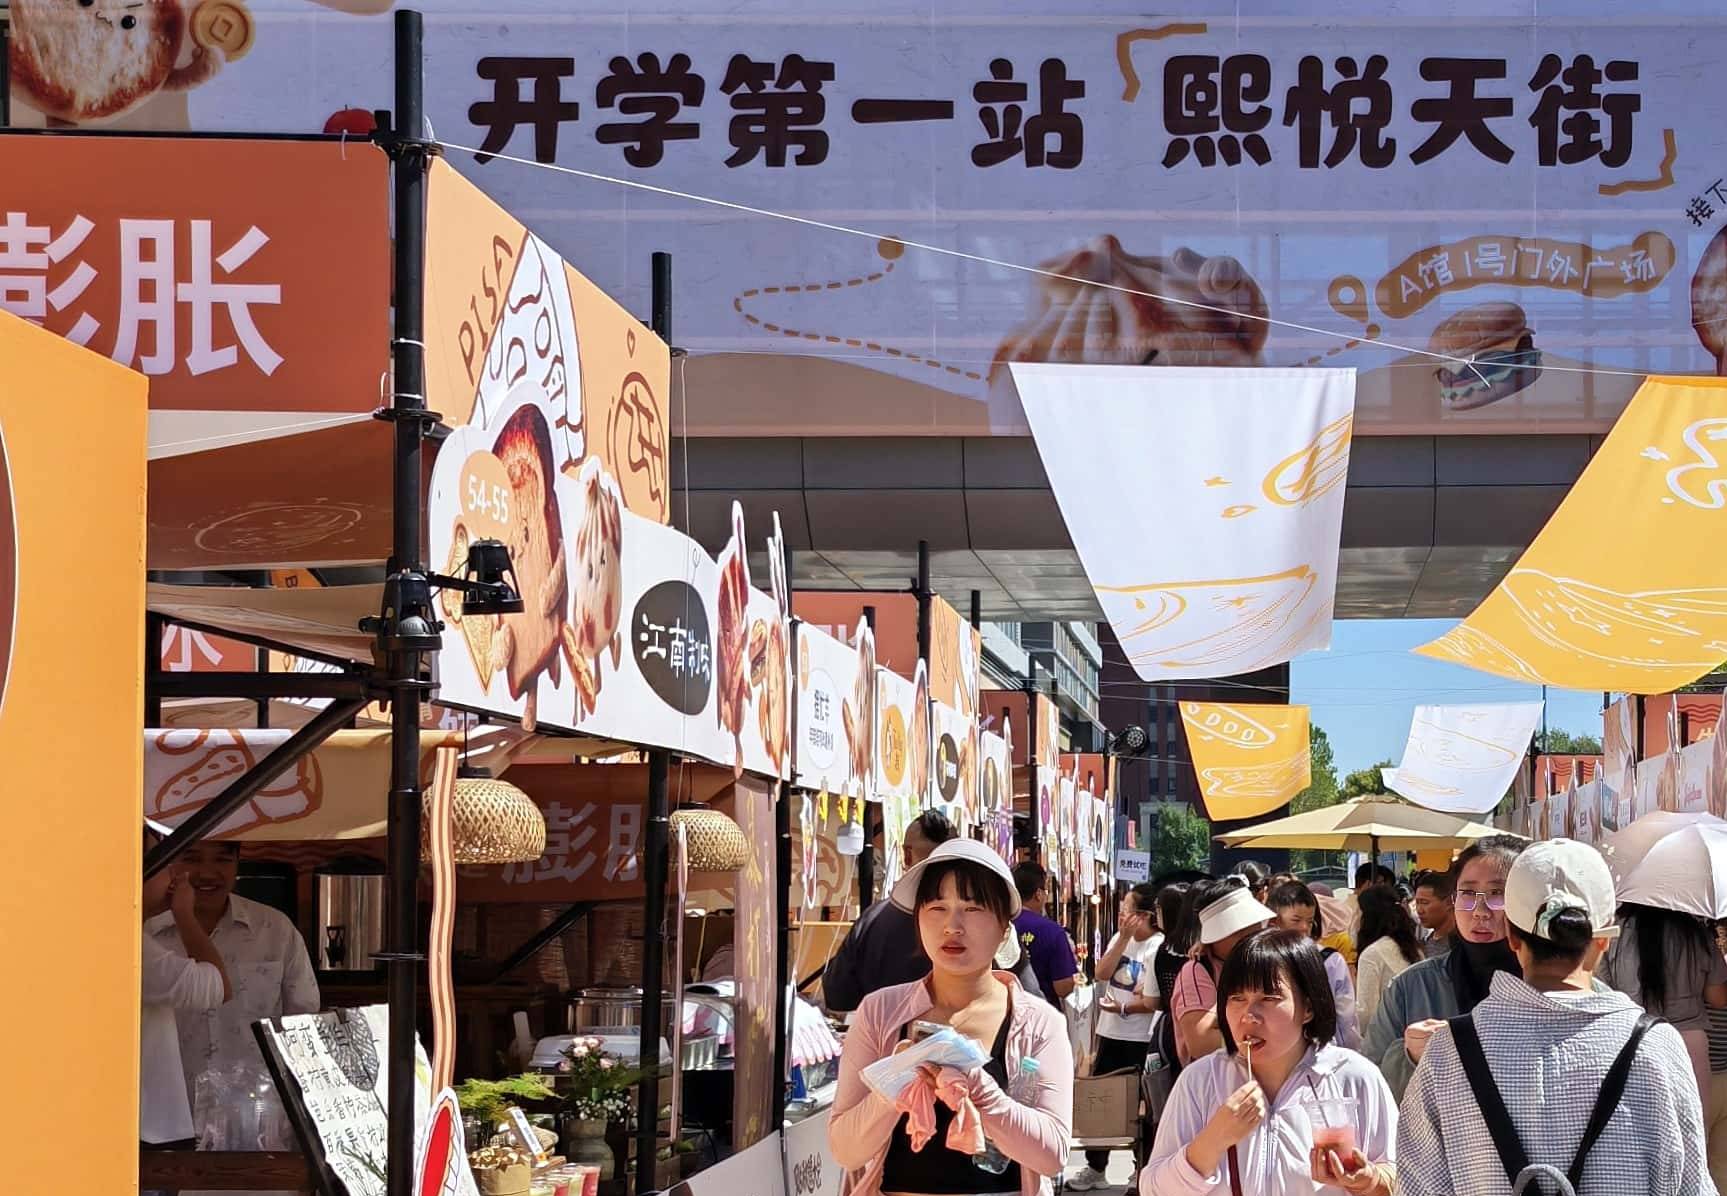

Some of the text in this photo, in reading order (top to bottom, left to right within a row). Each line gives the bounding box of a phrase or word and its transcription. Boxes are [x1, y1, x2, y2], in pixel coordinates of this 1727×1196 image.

[467, 51, 1642, 169] 开学第一站 熙悦天街
[467, 475, 510, 525] 54-55
